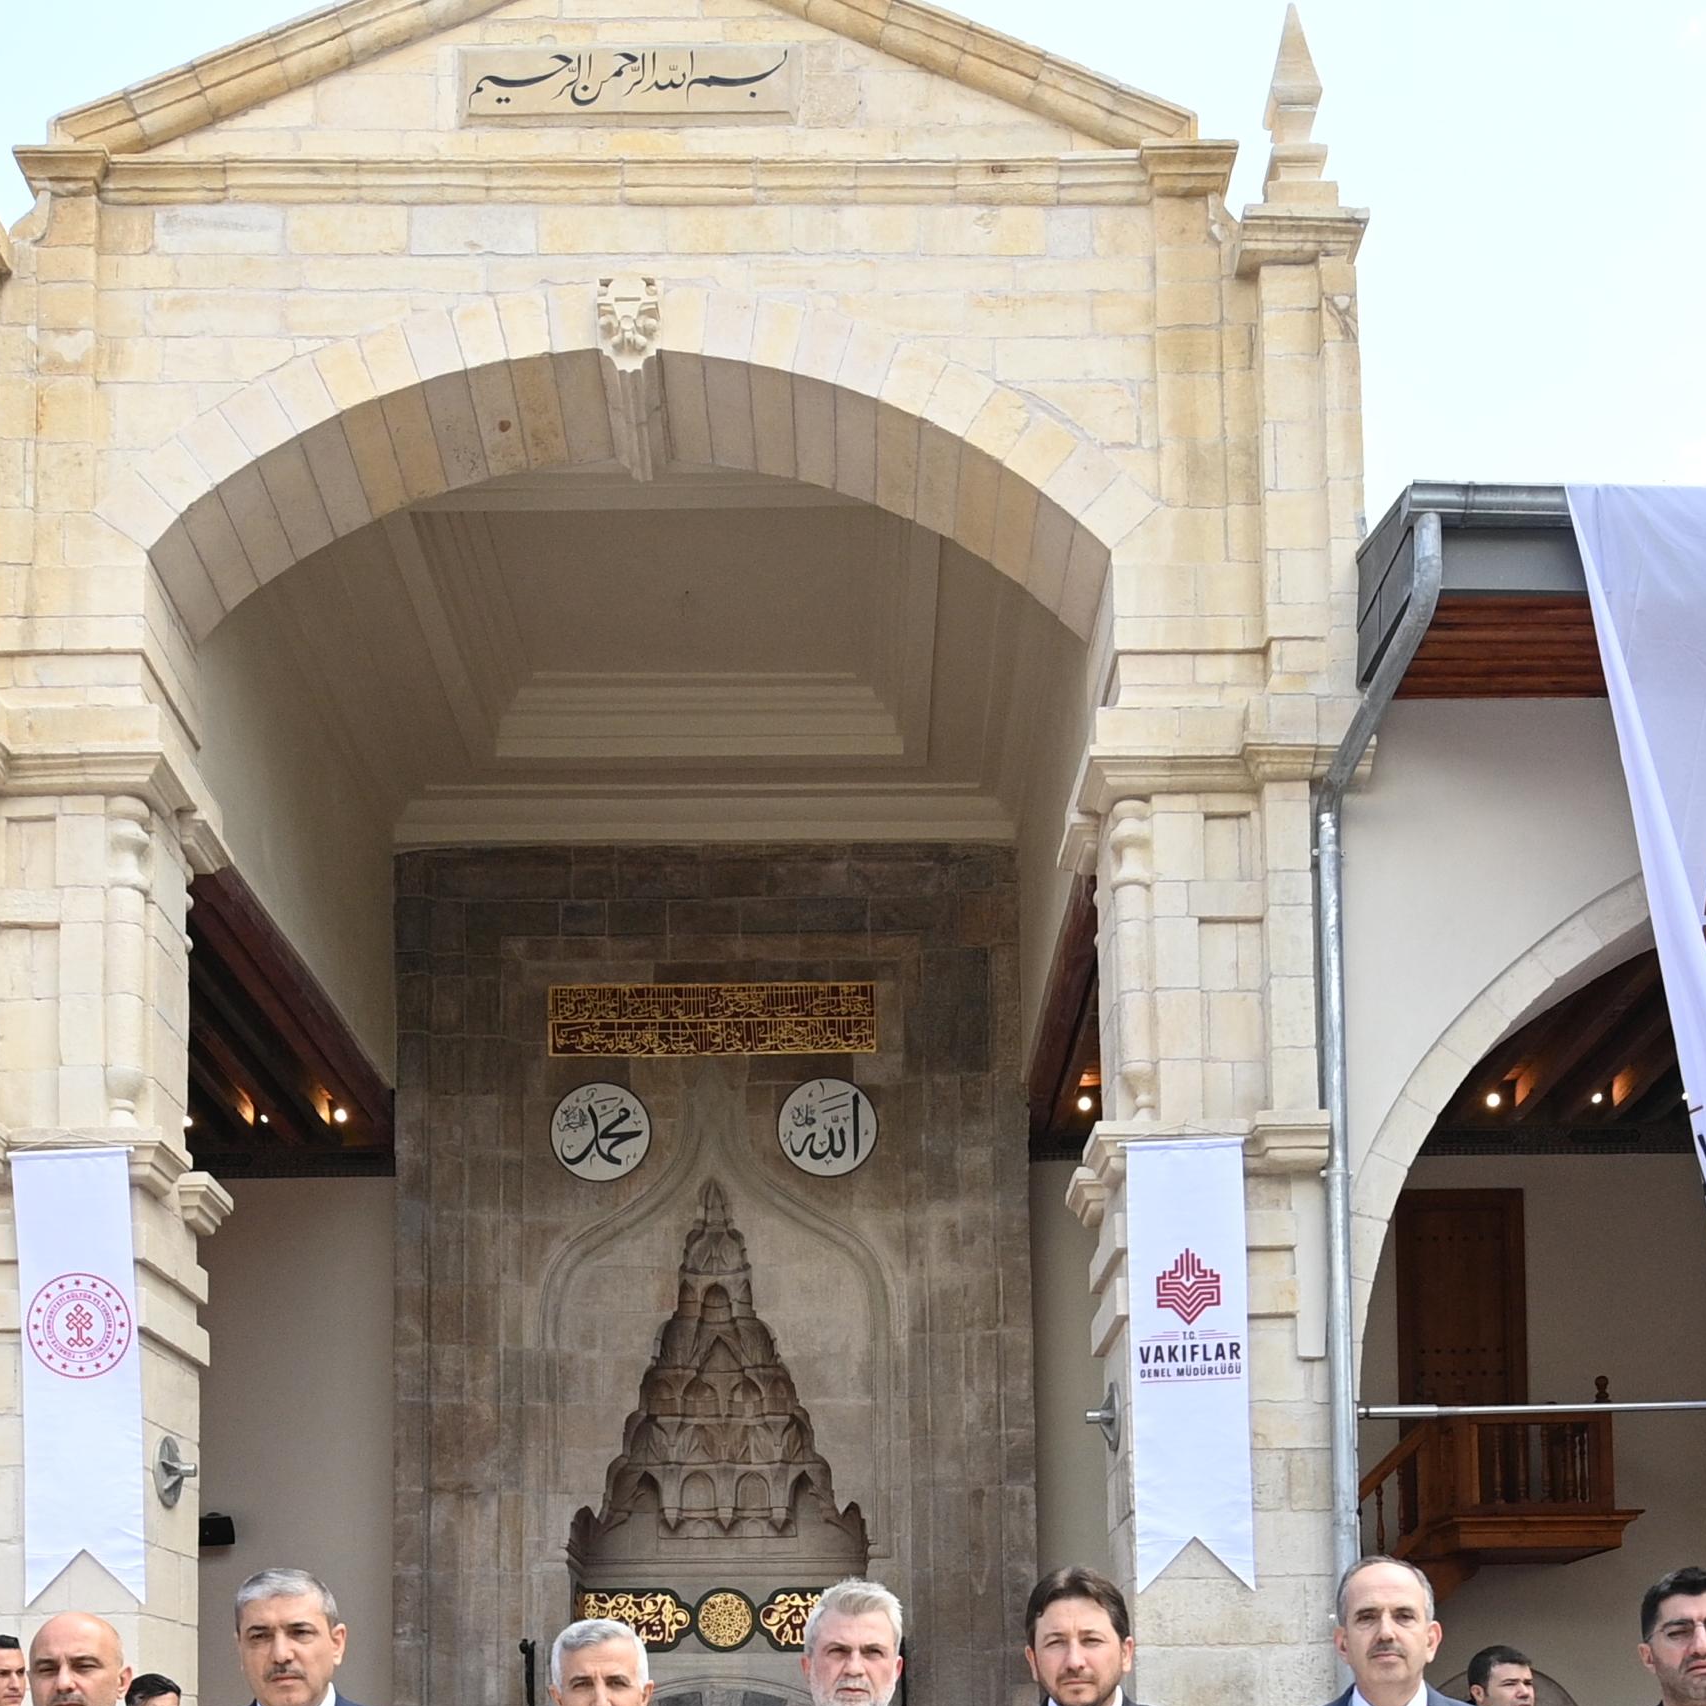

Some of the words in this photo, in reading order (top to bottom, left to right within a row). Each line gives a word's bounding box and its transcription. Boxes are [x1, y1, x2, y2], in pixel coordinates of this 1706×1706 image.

[1182, 1331, 1197, 1340] T.C.
[1139, 1342, 1241, 1364] VAKIFLAR
[1140, 1367, 1171, 1379] GENEL
[1176, 1362, 1241, 1377] MÜDÜRLÜĞÜ
